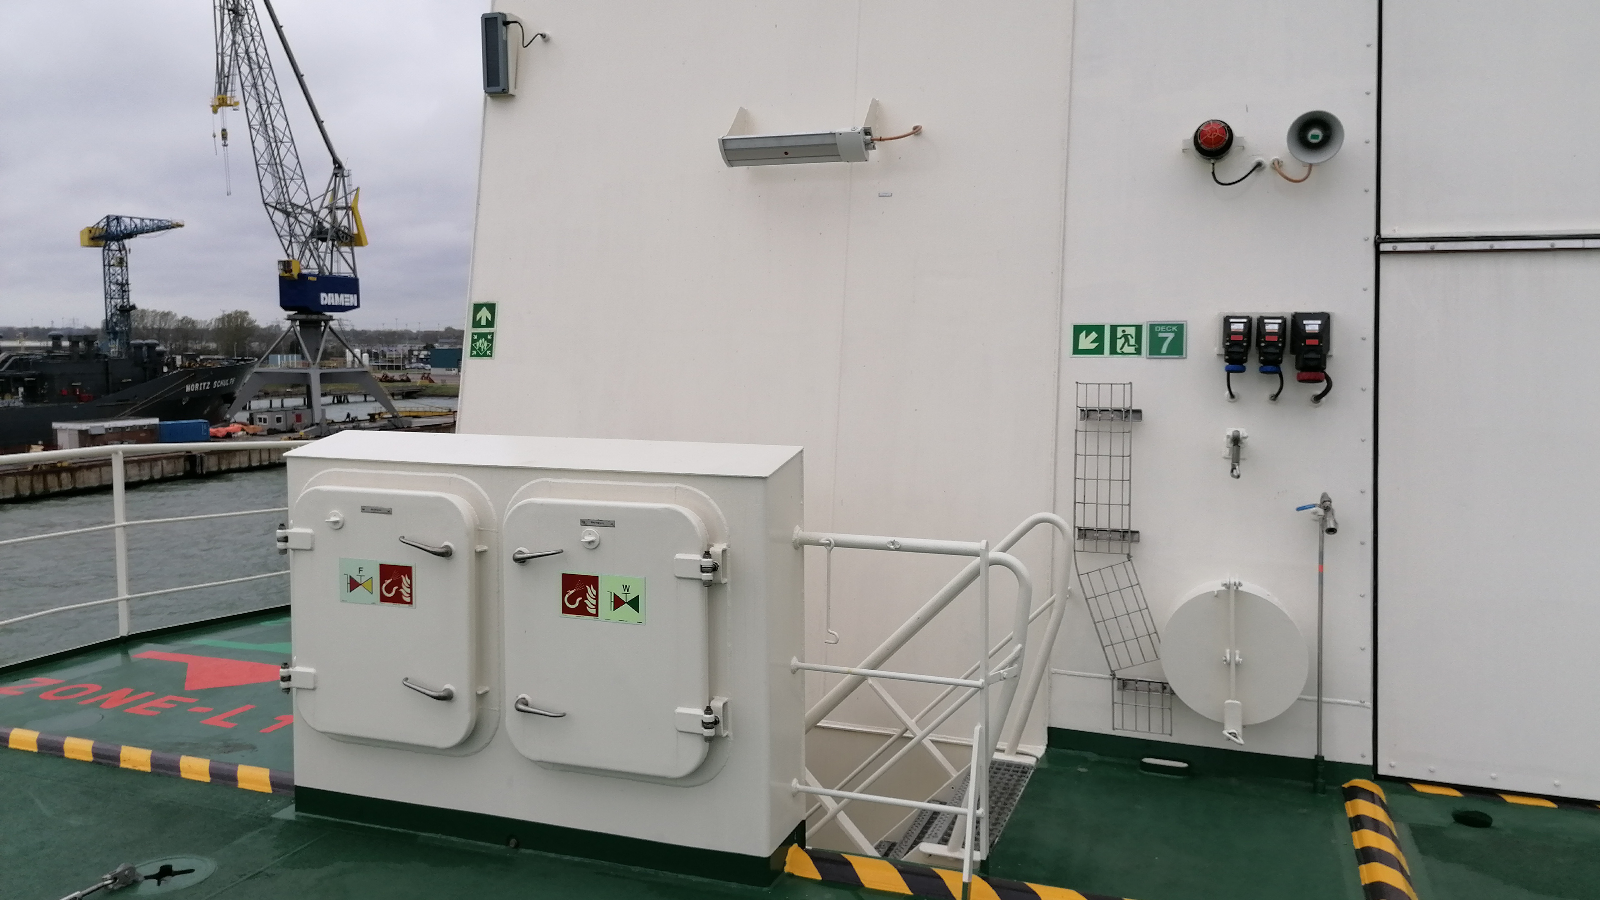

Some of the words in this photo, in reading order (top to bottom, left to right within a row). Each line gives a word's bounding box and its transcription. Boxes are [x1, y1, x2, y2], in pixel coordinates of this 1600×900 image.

[320, 292, 358, 306] DAMEN
[1158, 332, 1175, 354] 7
[185, 381, 211, 393] MORITZ
[622, 584, 631, 592] W
